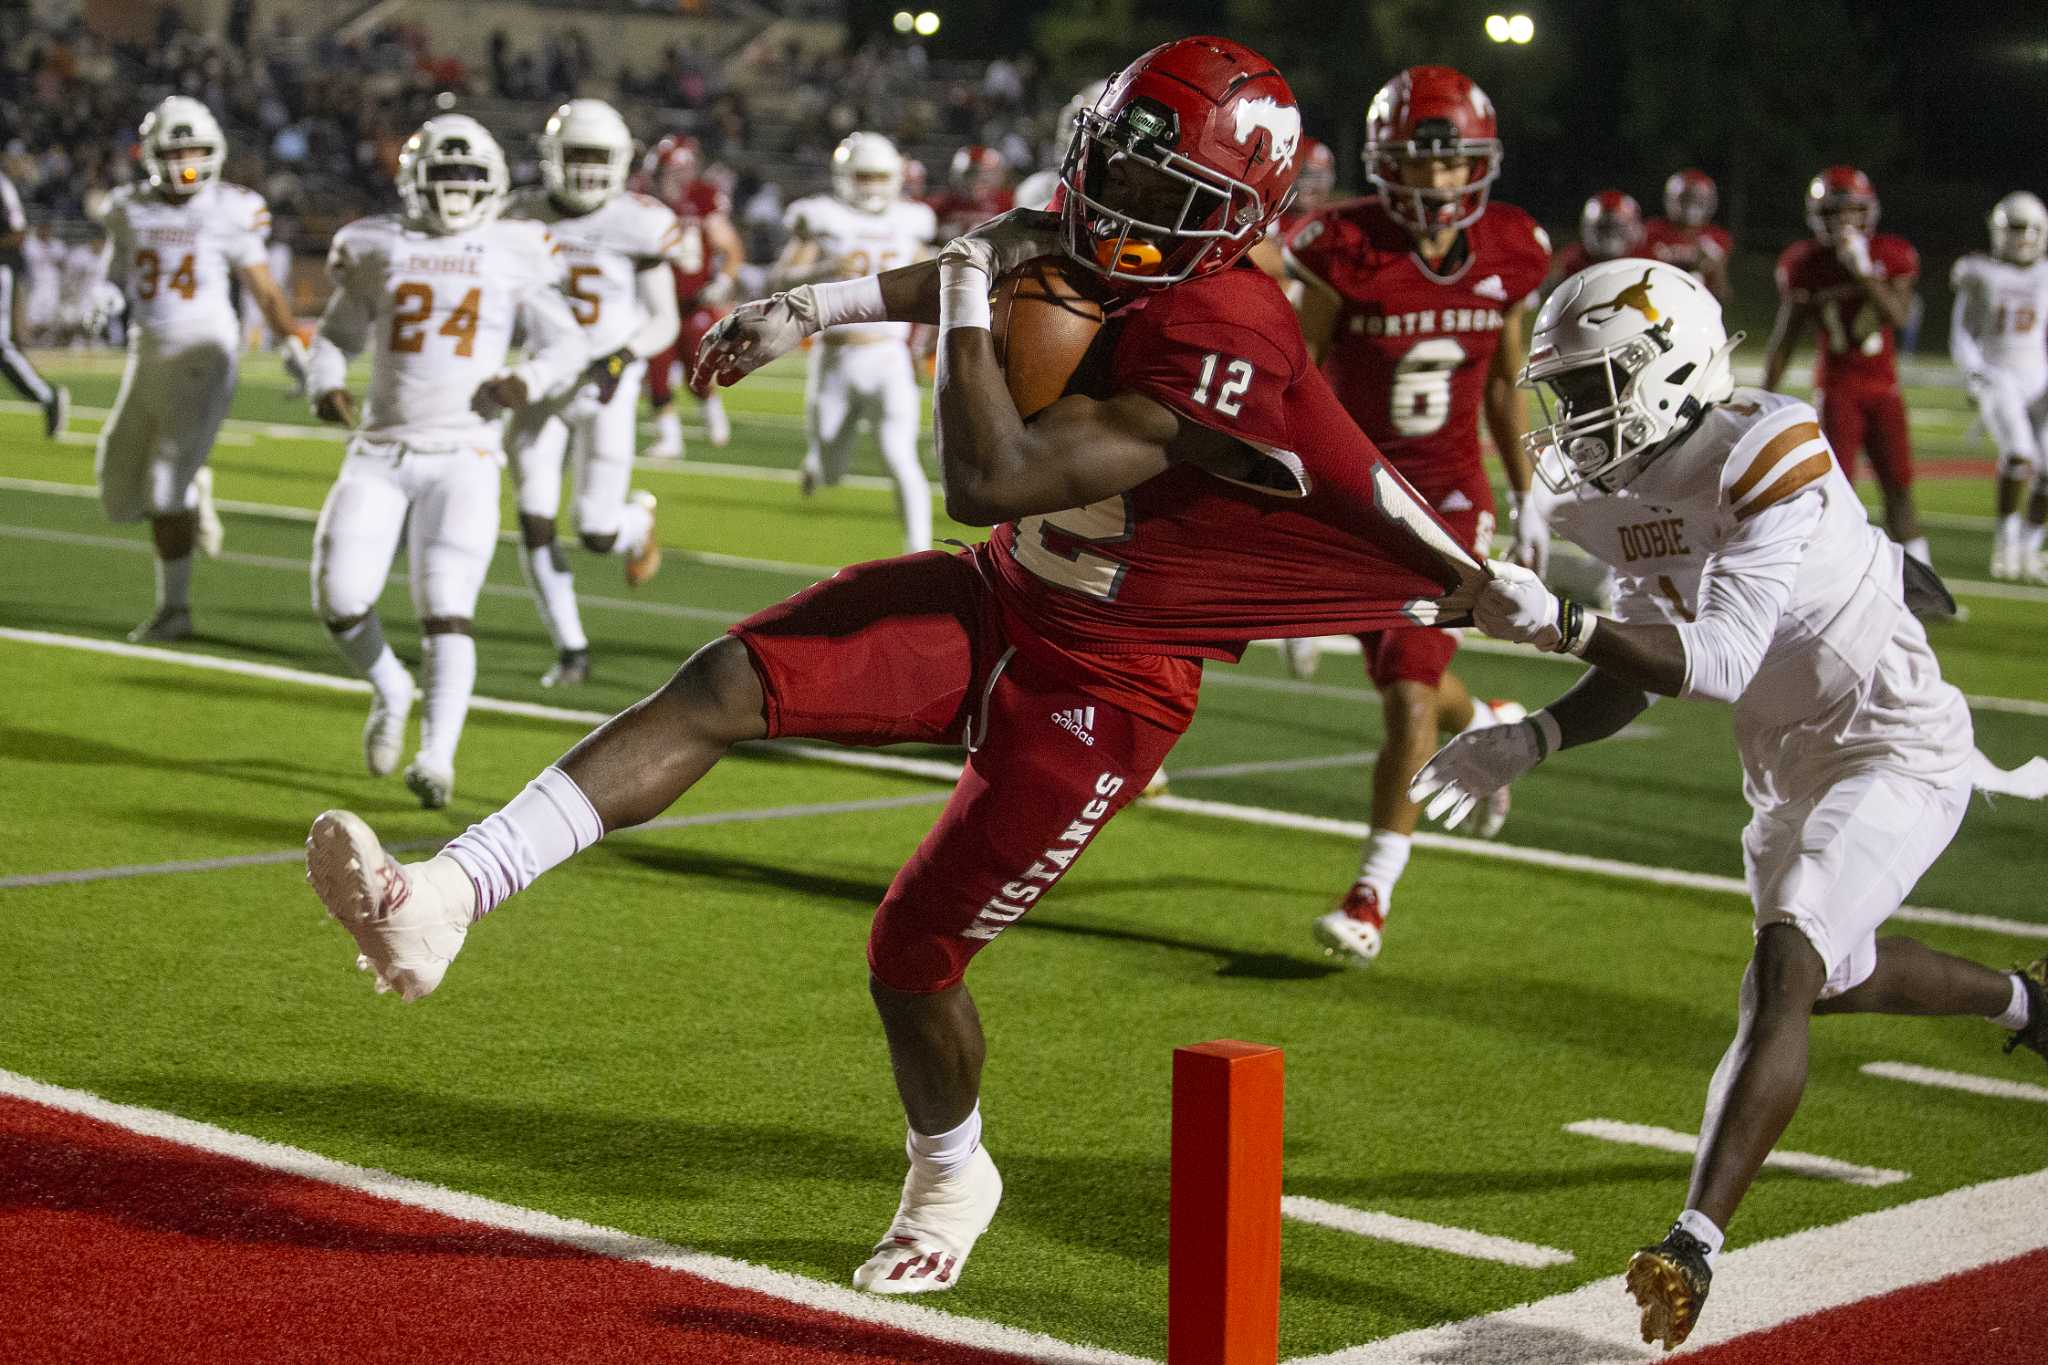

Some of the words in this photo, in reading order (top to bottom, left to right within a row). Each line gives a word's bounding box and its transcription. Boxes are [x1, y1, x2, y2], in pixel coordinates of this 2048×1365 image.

[135, 250, 198, 300] 34
[568, 265, 603, 326] 5
[390, 282, 482, 358] 24
[1193, 353, 1254, 417] 12
[1390, 336, 1467, 436] 6
[1617, 518, 1691, 562] DOBIE
[1050, 712, 1095, 746] adidas
[961, 771, 1124, 940] MUSTANGS
